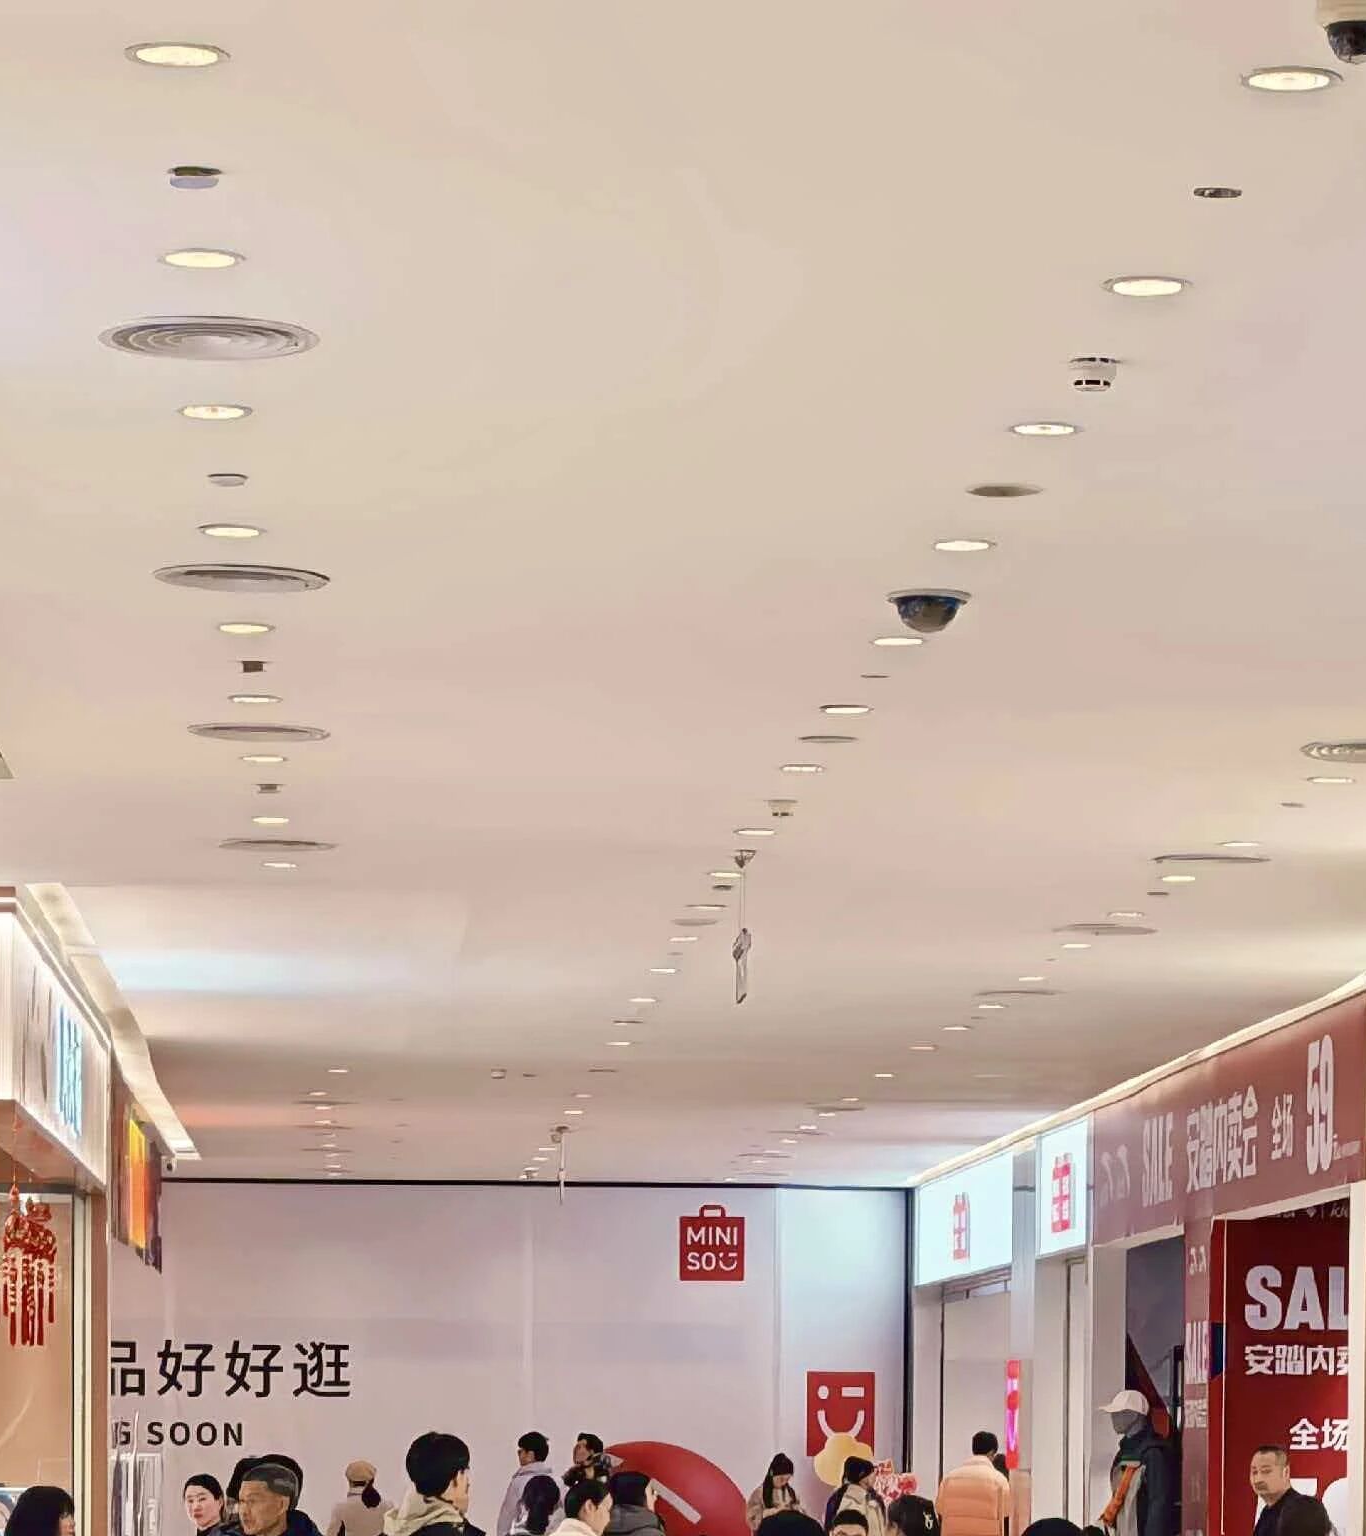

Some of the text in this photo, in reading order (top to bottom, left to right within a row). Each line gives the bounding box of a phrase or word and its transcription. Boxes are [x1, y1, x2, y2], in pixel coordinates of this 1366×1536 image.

[1307, 1034, 1334, 1175] 59
[686, 1226, 738, 1246] MINI
[110, 1340, 352, 1398] 品好好逛
[147, 1421, 243, 1447] SOON
[1290, 1418, 1349, 1451] 全场
